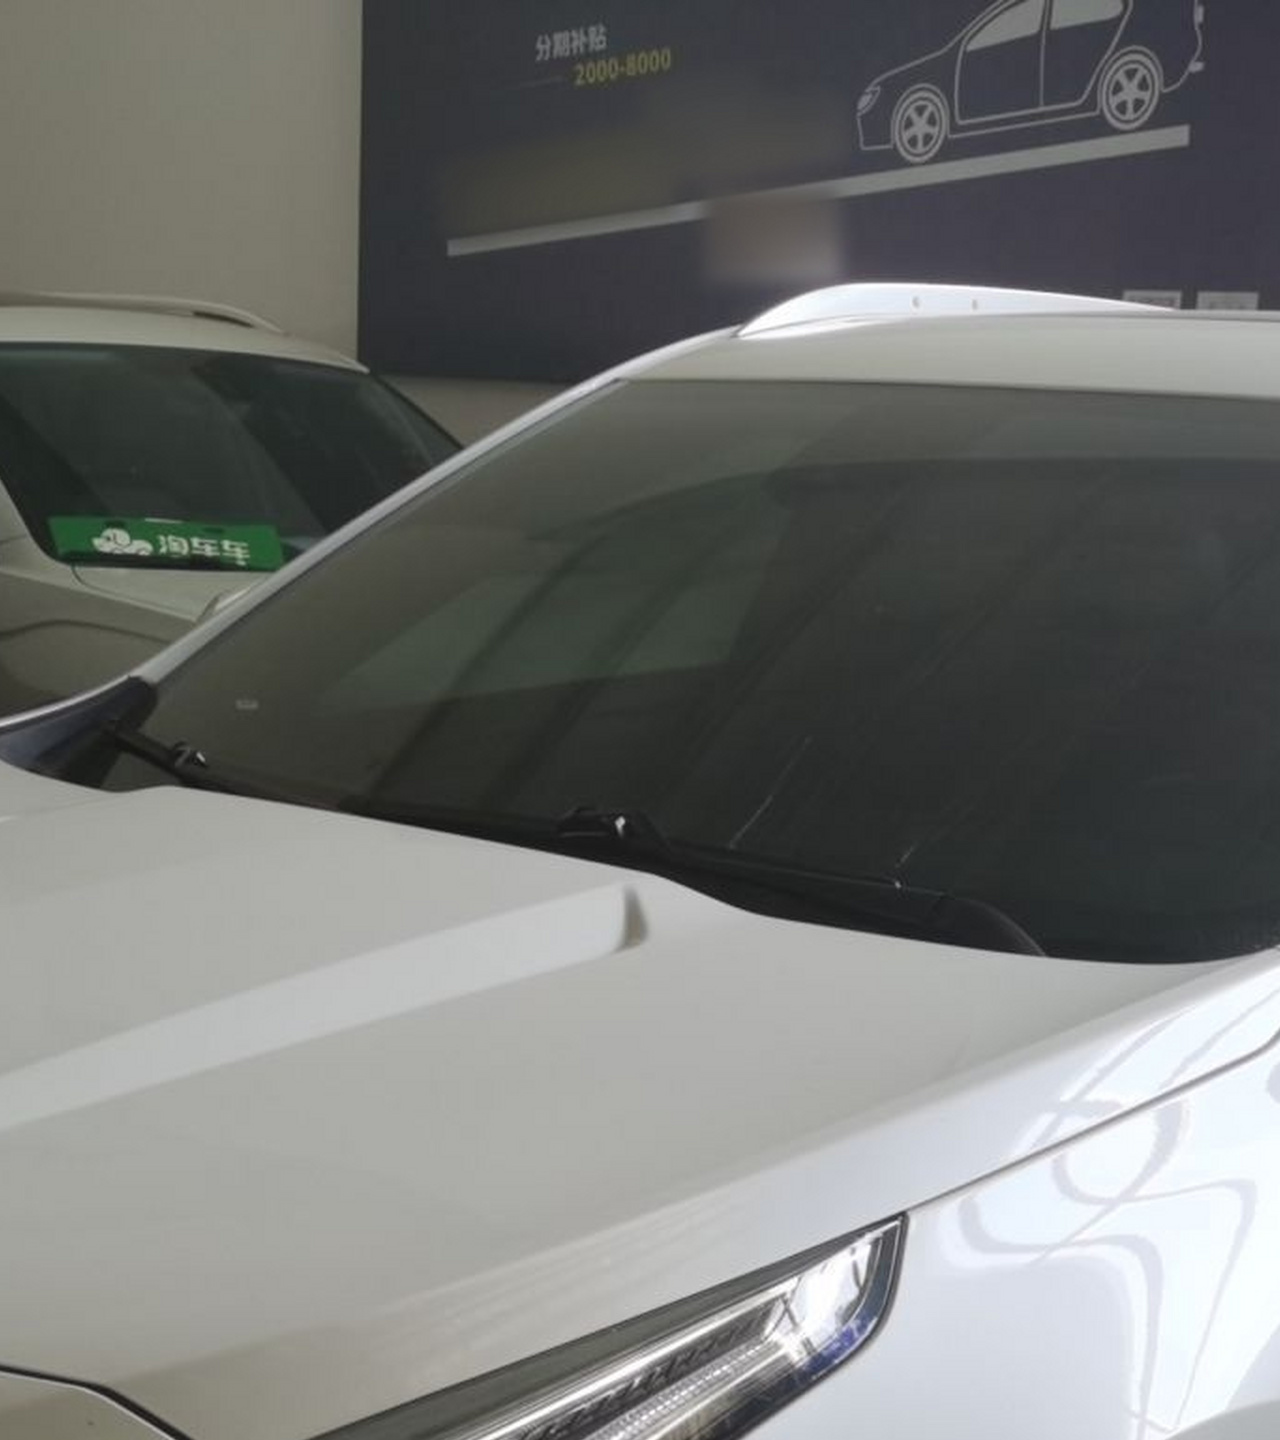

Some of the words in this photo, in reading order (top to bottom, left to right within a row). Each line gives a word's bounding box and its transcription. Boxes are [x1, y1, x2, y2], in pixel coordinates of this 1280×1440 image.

[535, 23, 608, 62] 分期补贴
[574, 48, 672, 86] 2000-8000
[157, 535, 250, 566] 淘车车
